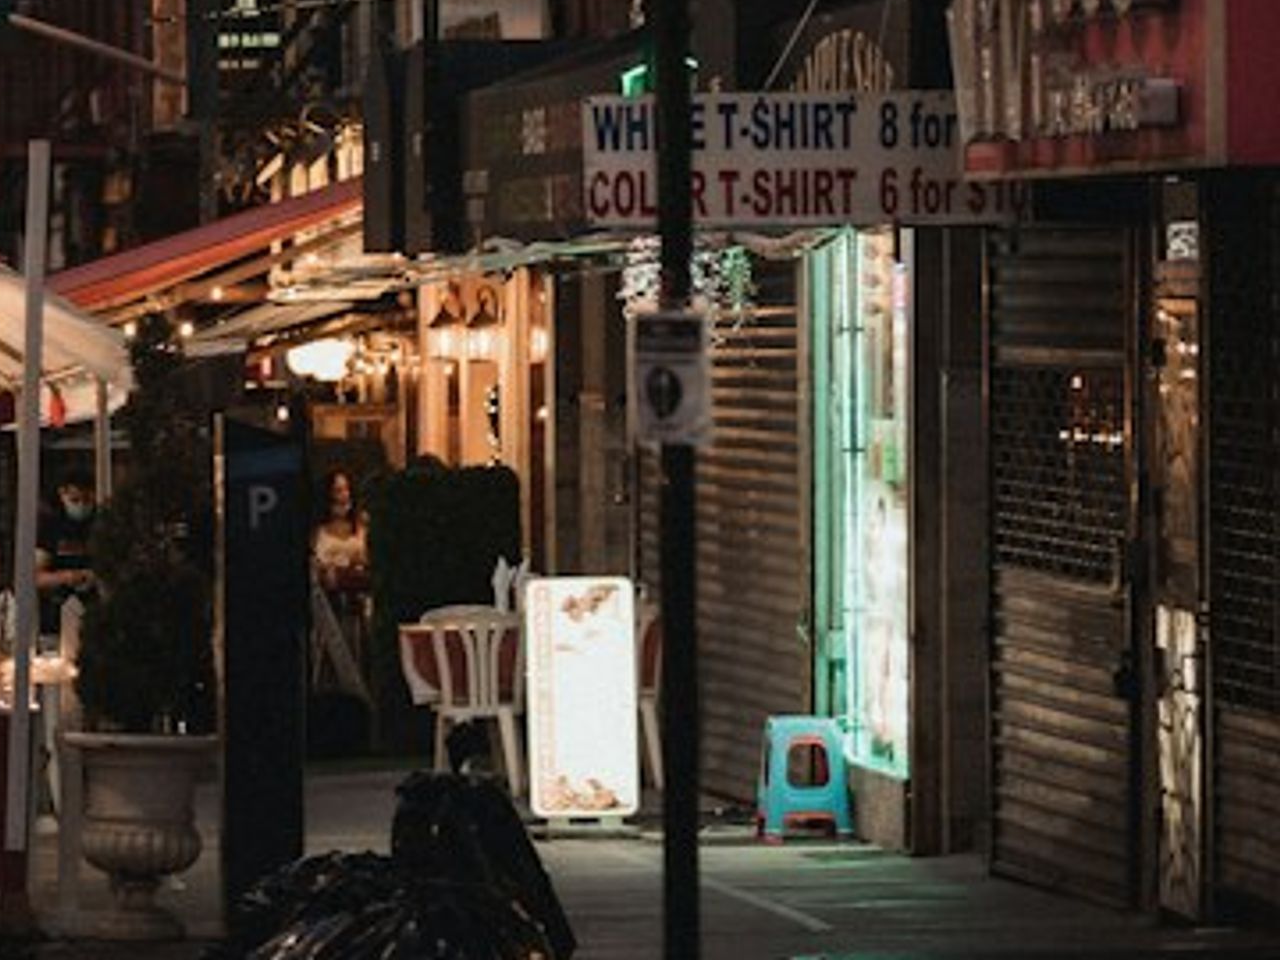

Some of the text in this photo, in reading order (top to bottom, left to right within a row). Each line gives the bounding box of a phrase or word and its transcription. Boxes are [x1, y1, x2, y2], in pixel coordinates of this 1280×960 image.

[593, 105, 706, 151] WHE
[717, 102, 858, 150] T-SHIRT
[881, 102, 898, 149] 8
[910, 102, 958, 149] for
[589, 170, 708, 218] COLR
[717, 170, 858, 217] T-SHIRT
[881, 168, 898, 215] 6
[910, 167, 958, 215] for
[248, 485, 278, 529] P
